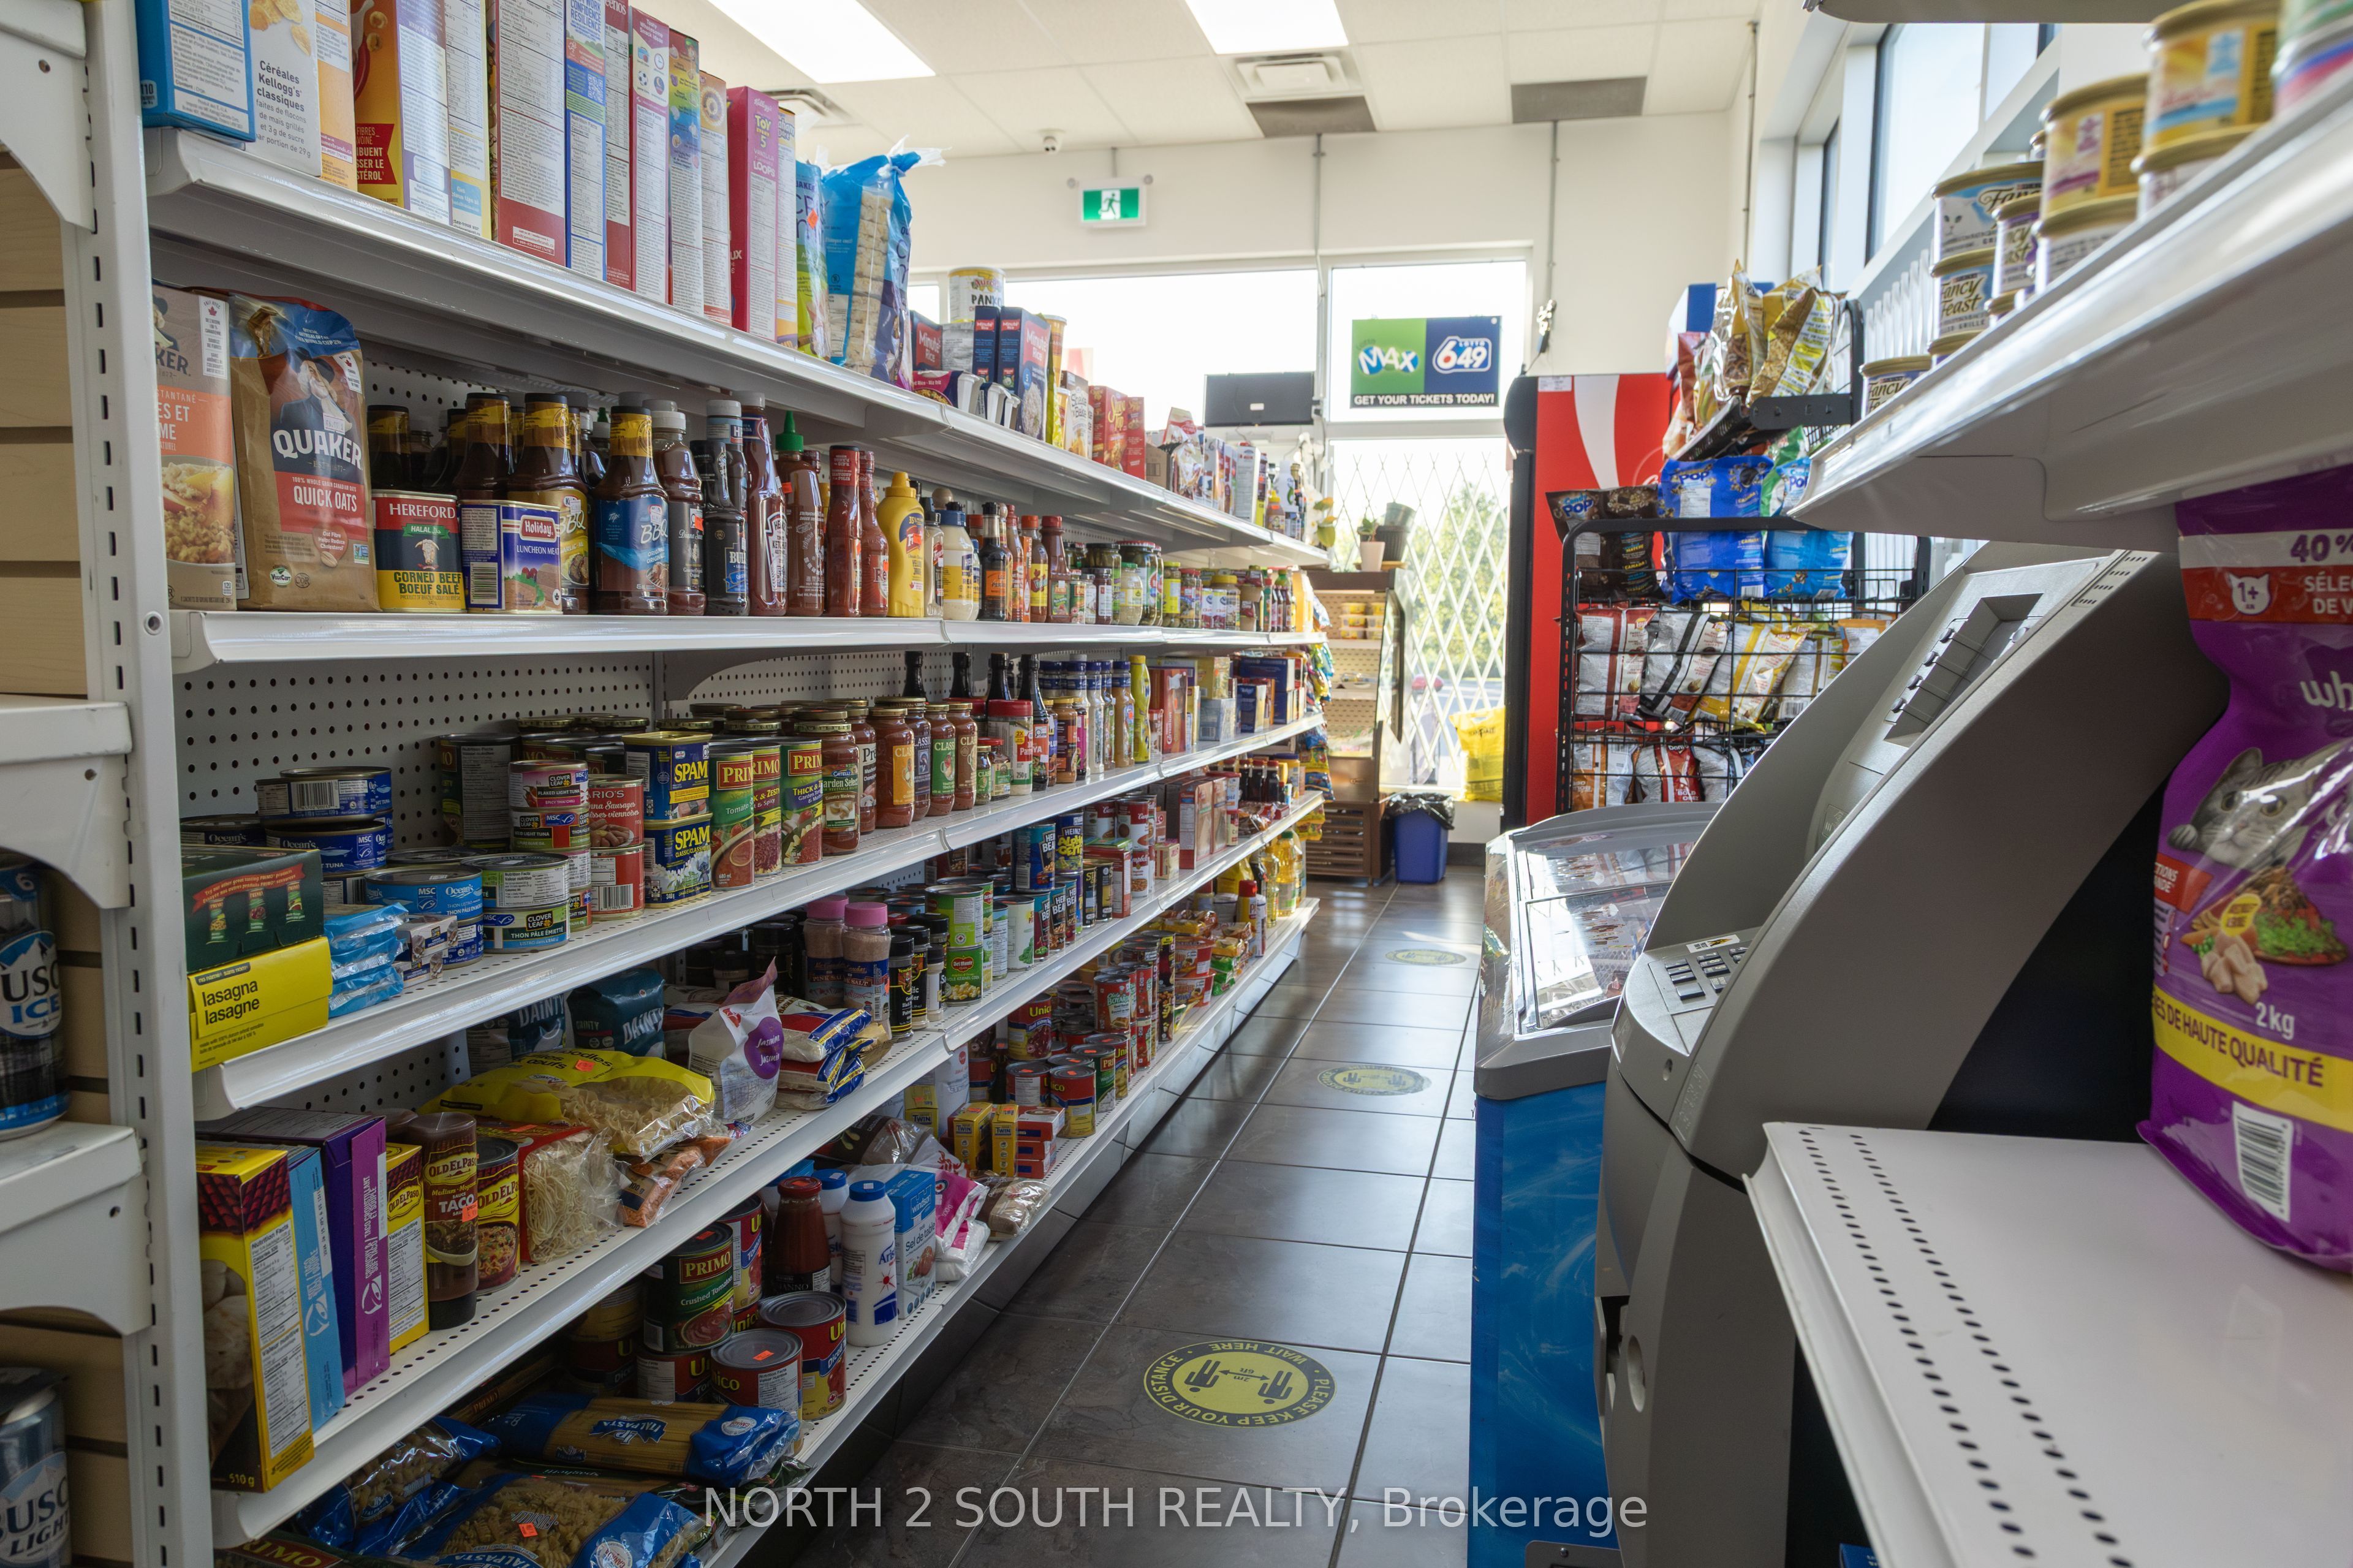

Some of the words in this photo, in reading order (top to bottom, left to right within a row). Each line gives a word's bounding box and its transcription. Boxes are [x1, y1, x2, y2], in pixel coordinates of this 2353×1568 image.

[570, 1, 601, 23] CONFIDENCE
[571, 9, 601, 32] RESILIENCE
[260, 60, 300, 84] Céréales
[259, 73, 300, 97] Kellogg's
[257, 87, 305, 112] classiques
[256, 99, 274, 112] faites
[285, 109, 306, 123] flocons
[269, 115, 284, 126] maïs
[286, 121, 304, 133] grillés
[755, 115, 771, 129] TOY
[288, 134, 304, 144] sucre
[357, 127, 376, 136] FIBRES
[267, 137, 289, 148] portion
[290, 143, 298, 153] de
[760, 135, 767, 148] 5
[376, 160, 384, 169] LE
[753, 161, 775, 177] LOOPS
[919, 330, 941, 353] Minute
[1026, 331, 1048, 352] Minute
[925, 350, 936, 363] Rice
[1358, 346, 1416, 374] MAX
[1354, 395, 1376, 405] GET
[1377, 395, 1407, 405] YOUR
[1409, 394, 1453, 404] TICKETS
[1455, 393, 1495, 403] TODAY!
[175, 405, 189, 422] ET
[273, 429, 362, 471] QUAKER
[294, 485, 333, 508] QUICK
[335, 491, 357, 512] OATS
[389, 502, 456, 519] HEREFORD
[411, 525, 431, 534] HALAL
[525, 520, 553, 537] Holiday
[640, 518, 668, 544] BBQ
[517, 545, 547, 555] LUNCHEON
[2290, 534, 2331, 562] 40
[394, 571, 435, 583] CORNED
[439, 572, 461, 583] BEEF
[400, 583, 433, 595] BOEUF
[436, 581, 460, 595] SALÉ
[2313, 598, 2339, 613] DE
[674, 760, 709, 783] SPAM
[605, 800, 636, 811] Sausages
[726, 803, 749, 814] Tomato
[605, 810, 639, 819] viennoises
[209, 834, 246, 843] Ocean's
[675, 825, 710, 850] SPAM
[445, 884, 474, 898] Ocean's
[545, 926, 563, 935] ÉMIETTÉ
[202, 980, 258, 1007] lasagna
[11, 993, 60, 1024] ICE
[205, 998, 259, 1025] lasagne
[756, 1035, 781, 1048] Jasmine
[2168, 1006, 2181, 1031] DE
[2183, 1016, 2227, 1055] HAUTE
[2229, 1037, 2324, 1088] QUALITÉ
[759, 1053, 780, 1066] Jasmin
[912, 1114, 931, 1123] TWIN
[957, 1125, 972, 1134] TWIN
[429, 1164, 450, 1177] OLD
[450, 1160, 462, 1173] EL
[388, 1199, 400, 1213] OLD
[439, 1194, 474, 1213] TACO
[912, 1195, 931, 1213] windsor
[252, 1232, 275, 1249] Nutrition
[276, 1225, 289, 1237] Facts
[906, 1237, 915, 1251] Sel
[916, 1233, 923, 1244] de
[924, 1222, 936, 1238] table
[685, 1251, 730, 1277] PRIMO
[680, 1292, 710, 1306] Crushed
[1208, 1343, 1258, 1351] HERE
[1264, 1346, 1308, 1365] WAIT
[1151, 1355, 1184, 1403] DISTANCE
[1292, 1379, 1330, 1415] PLEASE
[1173, 1403, 1229, 1423] YOUR
[1237, 1411, 1294, 1425] KEEP
[601, 1419, 661, 1434] ITALPASTA
[229, 1473, 246, 1485] 510
